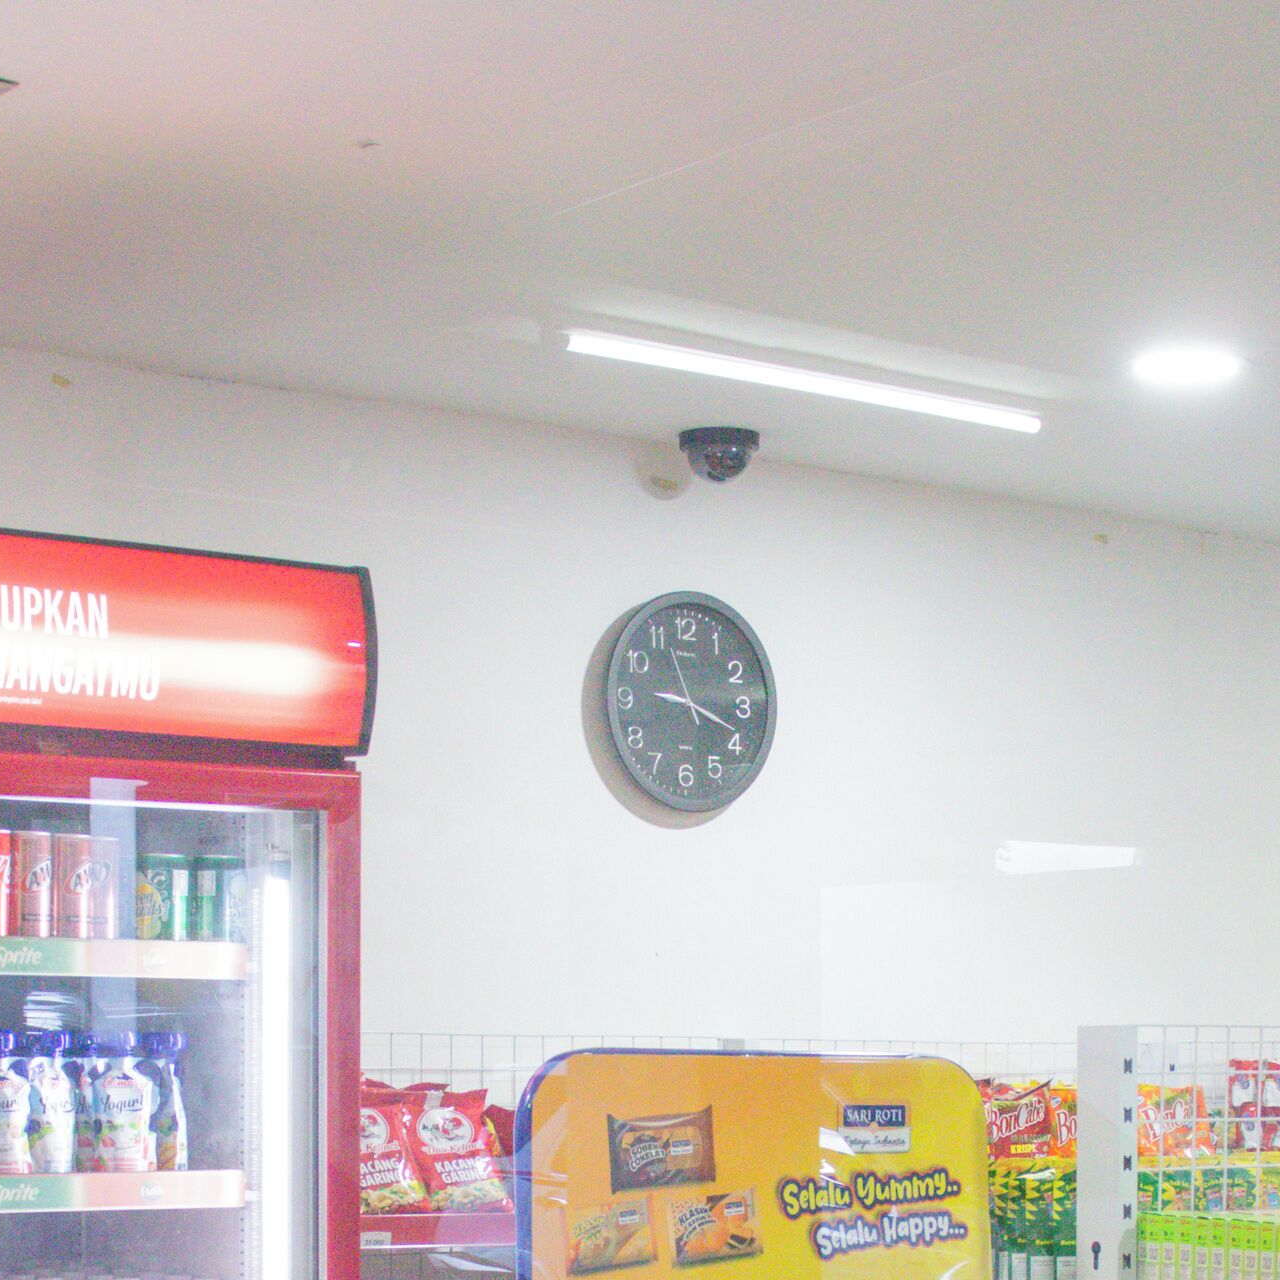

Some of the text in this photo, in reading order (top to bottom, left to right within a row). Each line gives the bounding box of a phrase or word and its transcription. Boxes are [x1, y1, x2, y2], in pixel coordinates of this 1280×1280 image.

[651, 626, 664, 649] 11
[676, 617, 696, 641] 12
[714, 632, 719, 655] 1
[627, 650, 649, 673] 10
[728, 661, 743, 683] 2
[618, 687, 633, 709] 9
[736, 696, 750, 718] 3
[628, 726, 643, 748] 8
[728, 733, 743, 755] 4
[648, 752, 662, 774] 7
[707, 756, 722, 778] 5
[679, 764, 693, 786] 6
[845, 1108, 903, 1127] SARI ROTI
[782, 1177, 851, 1218] Selalu
[816, 1221, 879, 1259] Selalu
